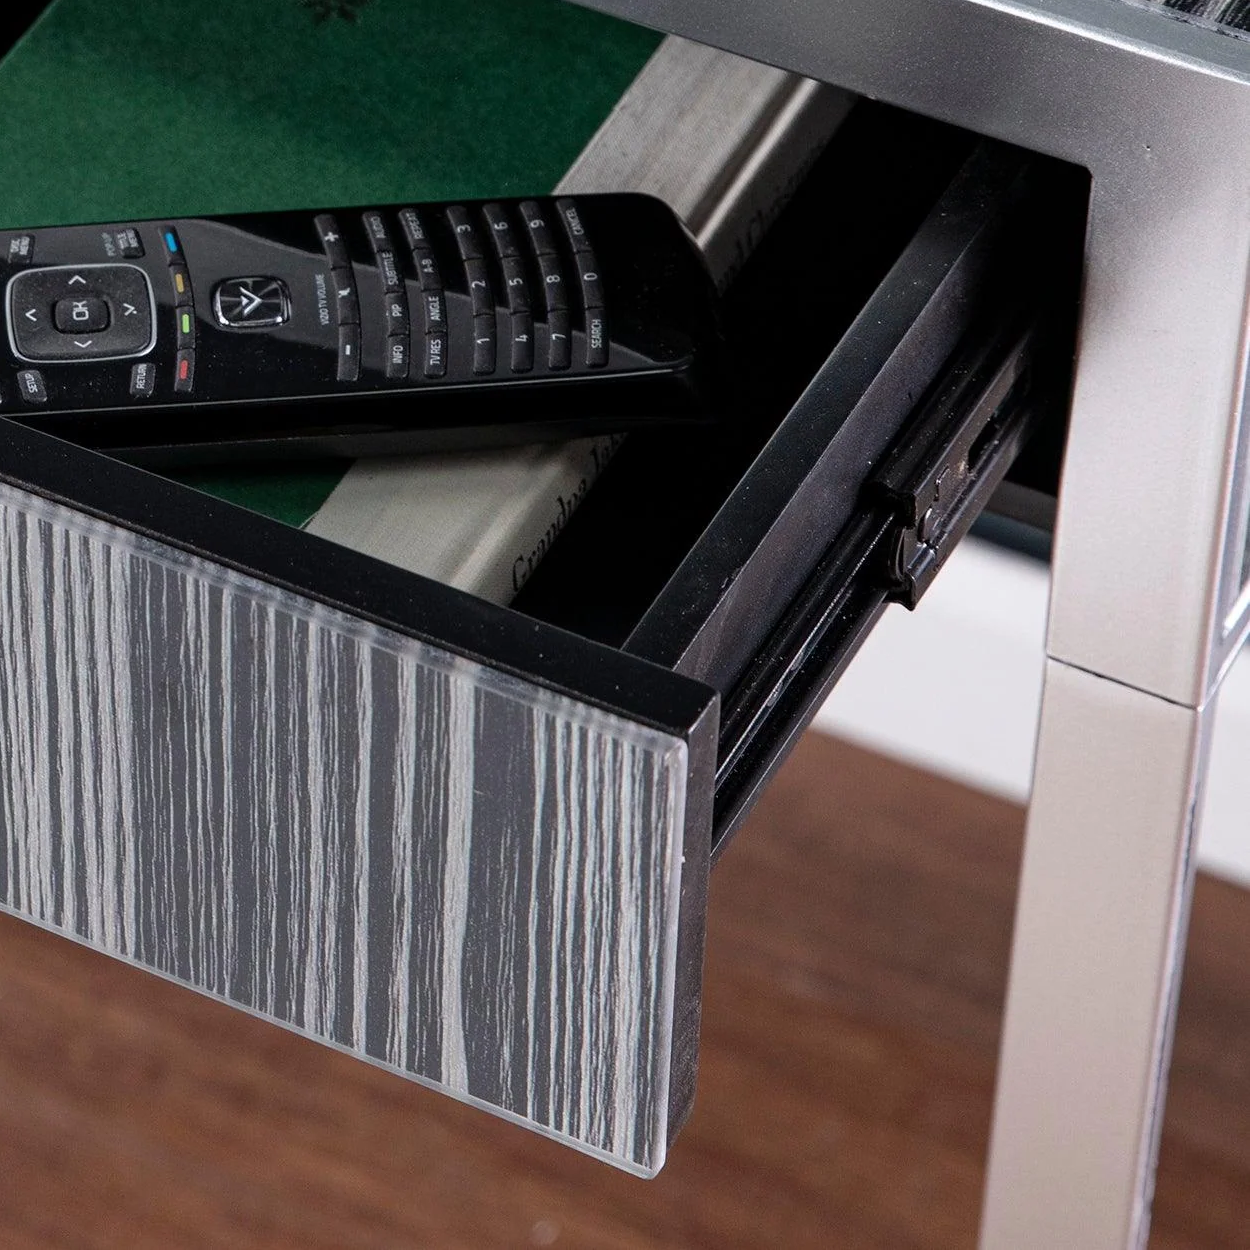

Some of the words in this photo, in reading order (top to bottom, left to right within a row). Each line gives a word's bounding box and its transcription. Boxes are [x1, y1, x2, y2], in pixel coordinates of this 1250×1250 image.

[457, 224, 471, 233] 3
[494, 221, 508, 230] 6
[530, 219, 545, 228] 9
[471, 280, 486, 288] 2
[509, 277, 523, 286] 5
[546, 274, 560, 283] 8
[72, 301, 89, 321] OK
[391, 304, 403, 317] PIP
[428, 296, 441, 321] ANGLE
[515, 334, 529, 342] 4
[591, 319, 602, 349] SEARCH
[430, 339, 442, 354] RES
[392, 345, 404, 364] INFO
[430, 354, 441, 365] TV
[136, 363, 147, 390] RETURN
[24, 372, 38, 394] SETUP
